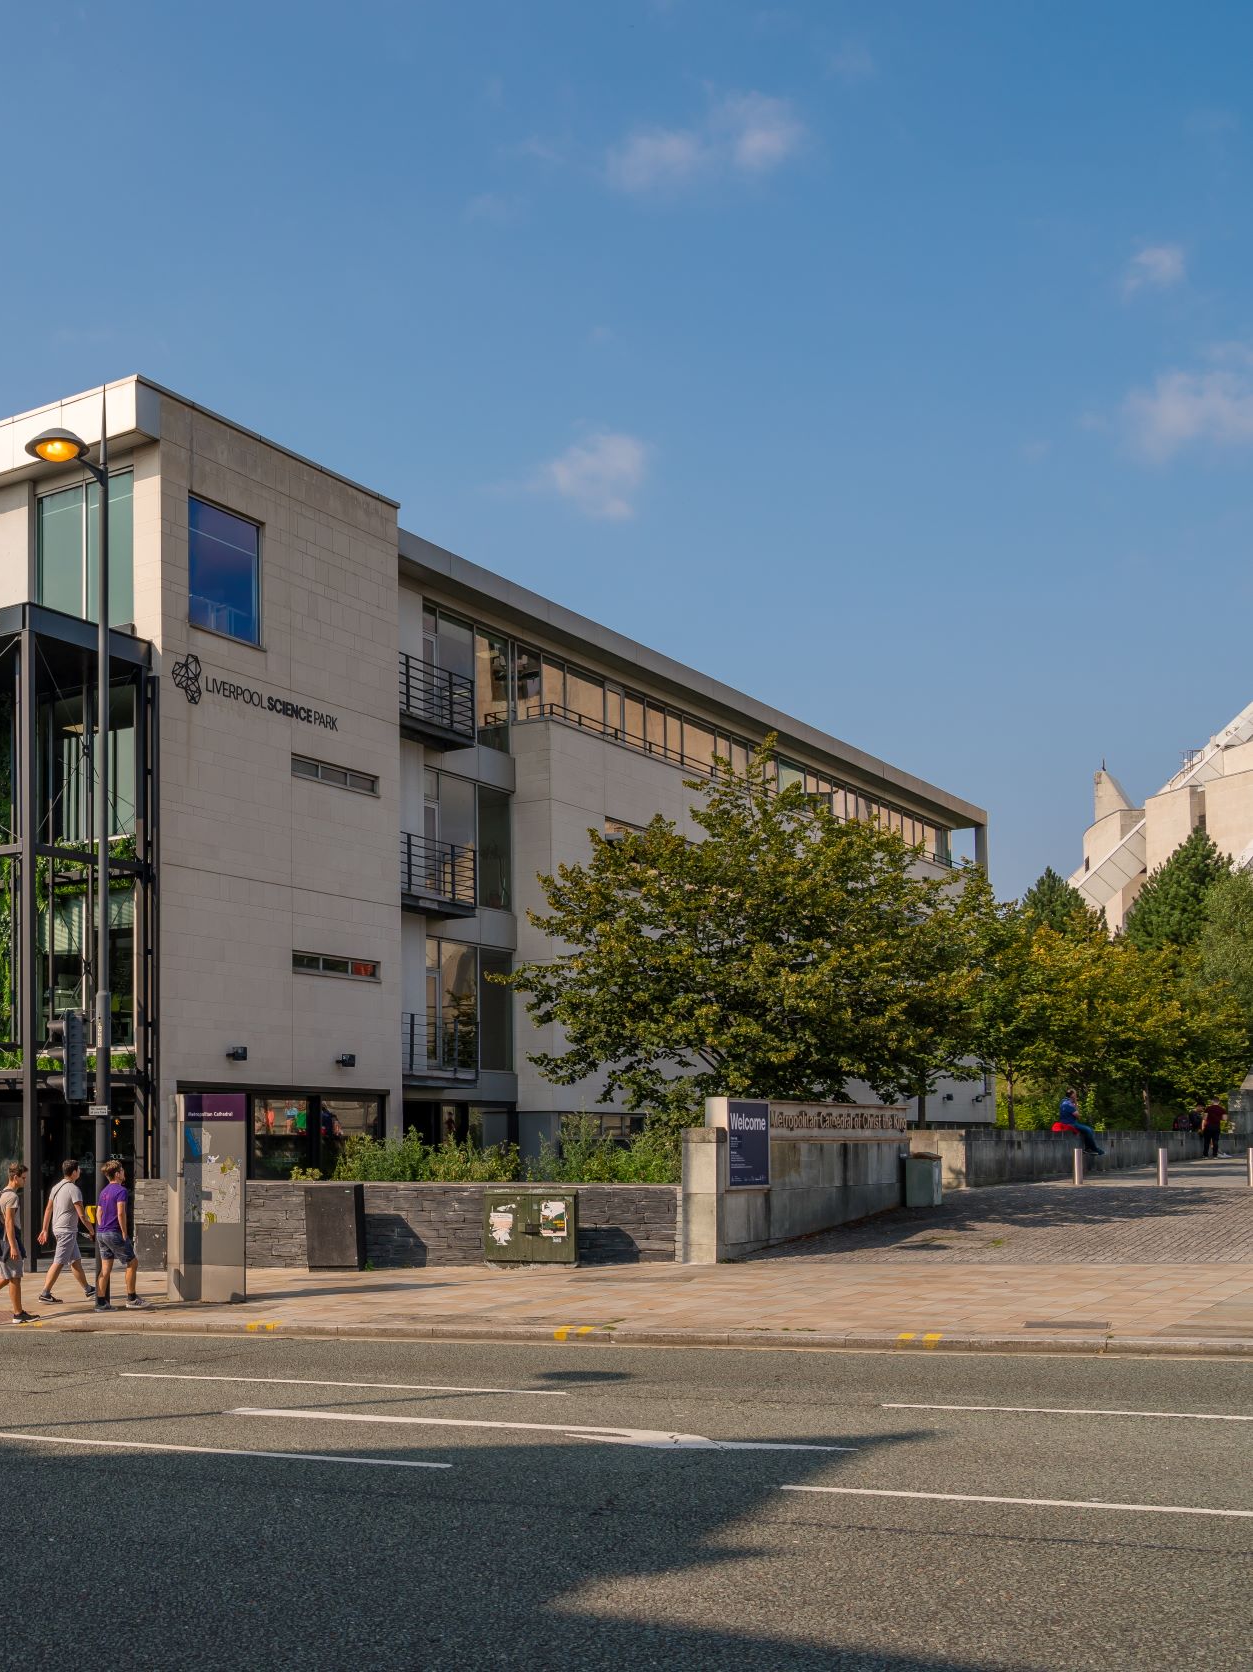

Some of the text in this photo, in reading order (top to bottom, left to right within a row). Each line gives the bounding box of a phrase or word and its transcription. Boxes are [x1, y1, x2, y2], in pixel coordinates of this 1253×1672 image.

[205, 675, 339, 732] LIVERPOOL SCIENCE PARK
[730, 1112, 766, 1131] Welcome
[770, 1110, 907, 1133] Metropolitan Cathedral of Christ the King
